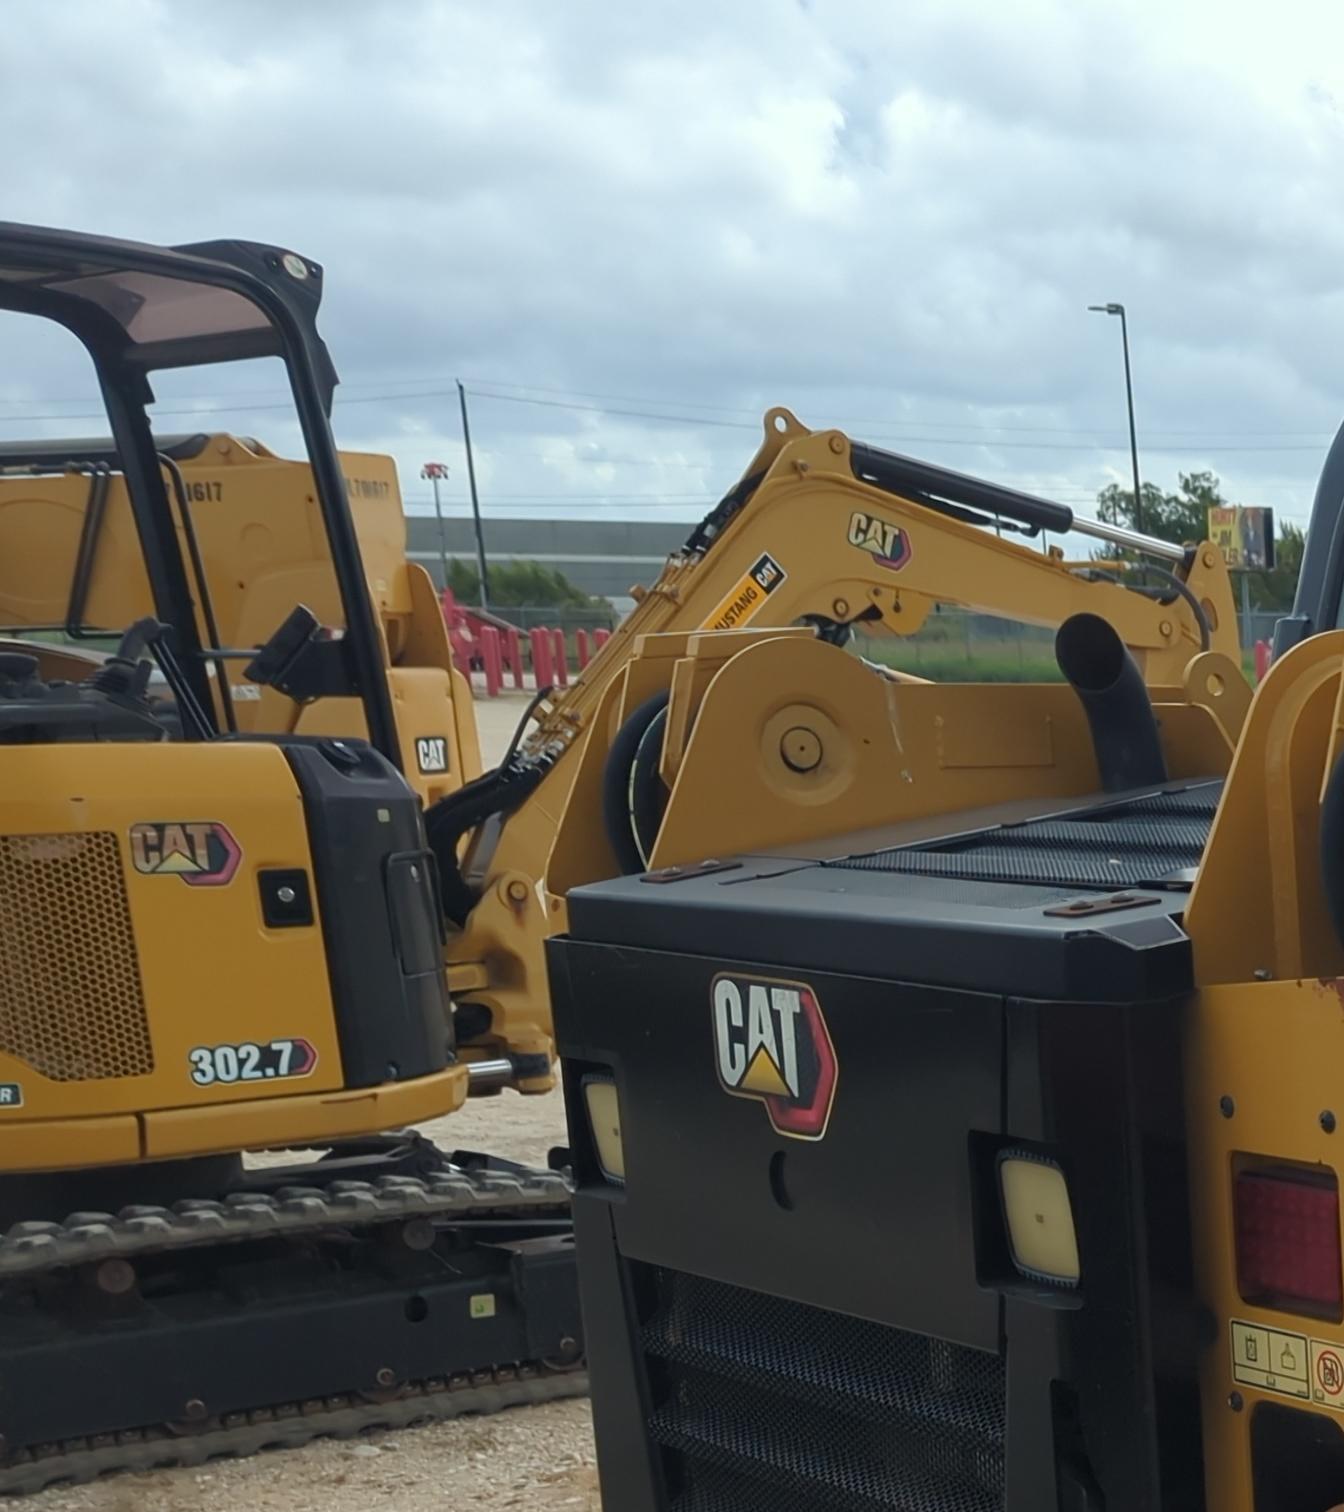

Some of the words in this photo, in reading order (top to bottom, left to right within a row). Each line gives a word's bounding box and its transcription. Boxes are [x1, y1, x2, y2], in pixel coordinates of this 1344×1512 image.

[848, 513, 900, 559] CAT
[714, 586, 758, 630] USTANG
[756, 561, 777, 587] CAT
[418, 739, 446, 770] CAT
[130, 823, 211, 872] CAT
[714, 979, 801, 1098] CAT
[190, 1041, 293, 1084] 302.7
[0, 1087, 12, 1103] R
